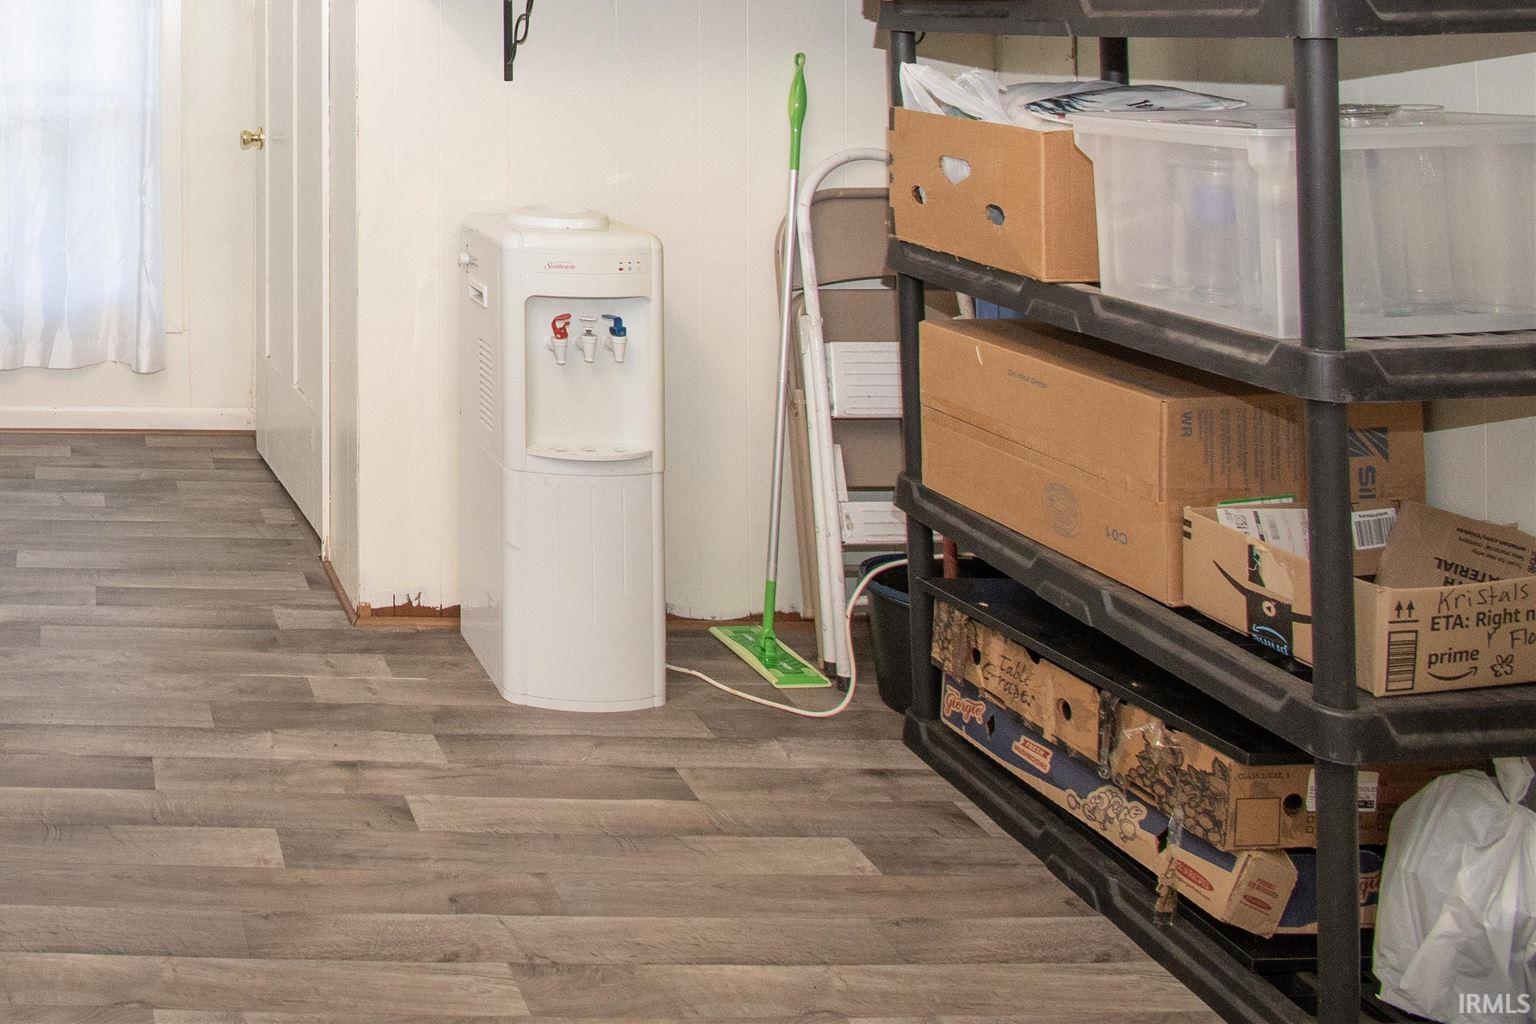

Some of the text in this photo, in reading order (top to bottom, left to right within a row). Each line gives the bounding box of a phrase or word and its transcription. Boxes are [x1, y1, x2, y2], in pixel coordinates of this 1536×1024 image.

[544, 261, 576, 272] Sunbeam
[1431, 614, 1470, 632] ETA:
[1476, 607, 1520, 629] Right
[1427, 647, 1480, 669] prime
